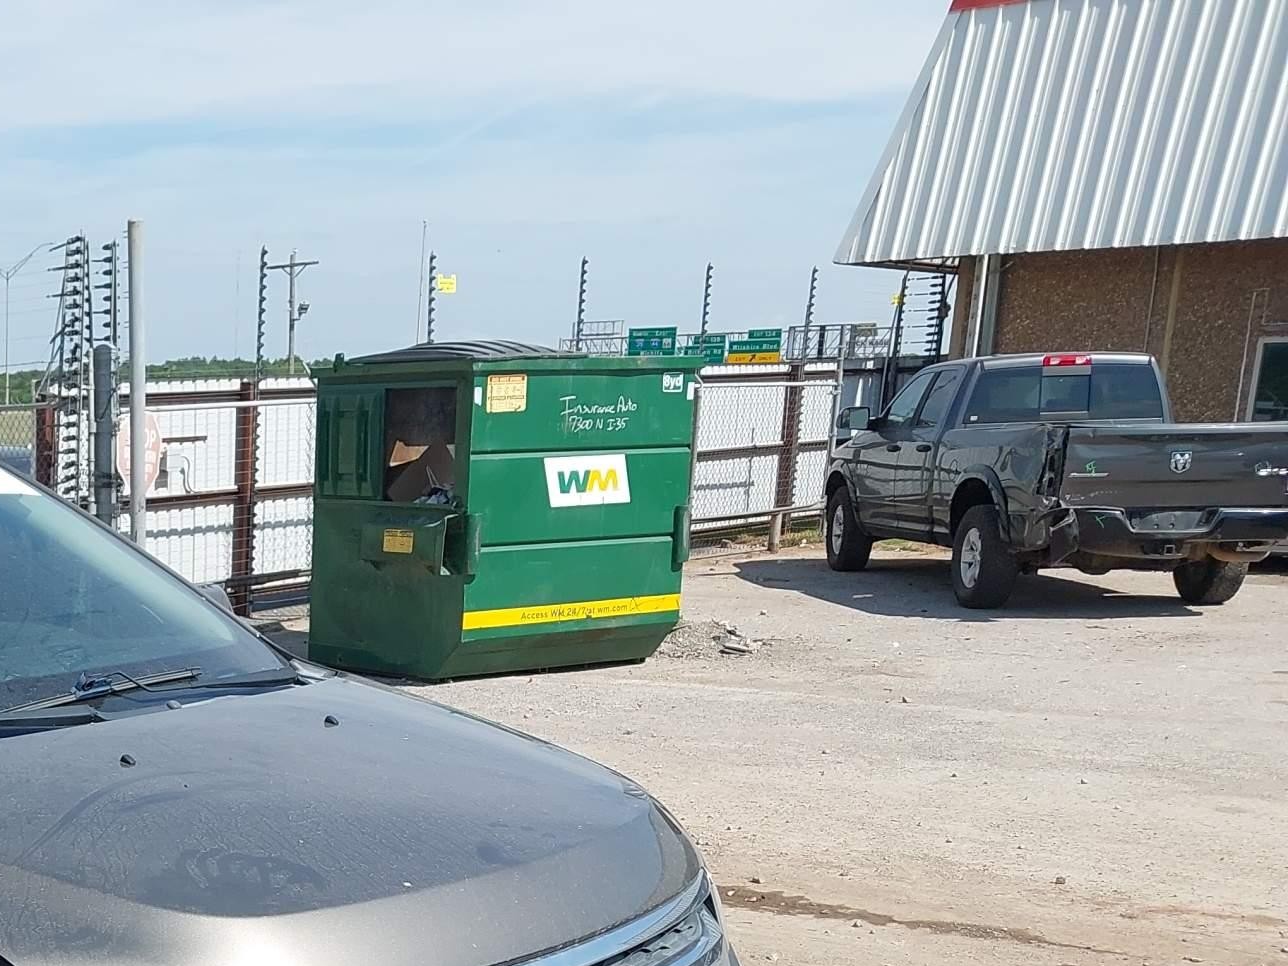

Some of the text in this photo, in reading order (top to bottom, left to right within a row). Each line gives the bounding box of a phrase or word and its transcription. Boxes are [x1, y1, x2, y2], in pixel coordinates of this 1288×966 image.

[664, 374, 682, 390] 8yd
[559, 395, 638, 416] Insurance Auto
[595, 418, 604, 430] N
[557, 469, 619, 494] WM
[520, 611, 549, 620] Access
[597, 604, 629, 614] wm.com
